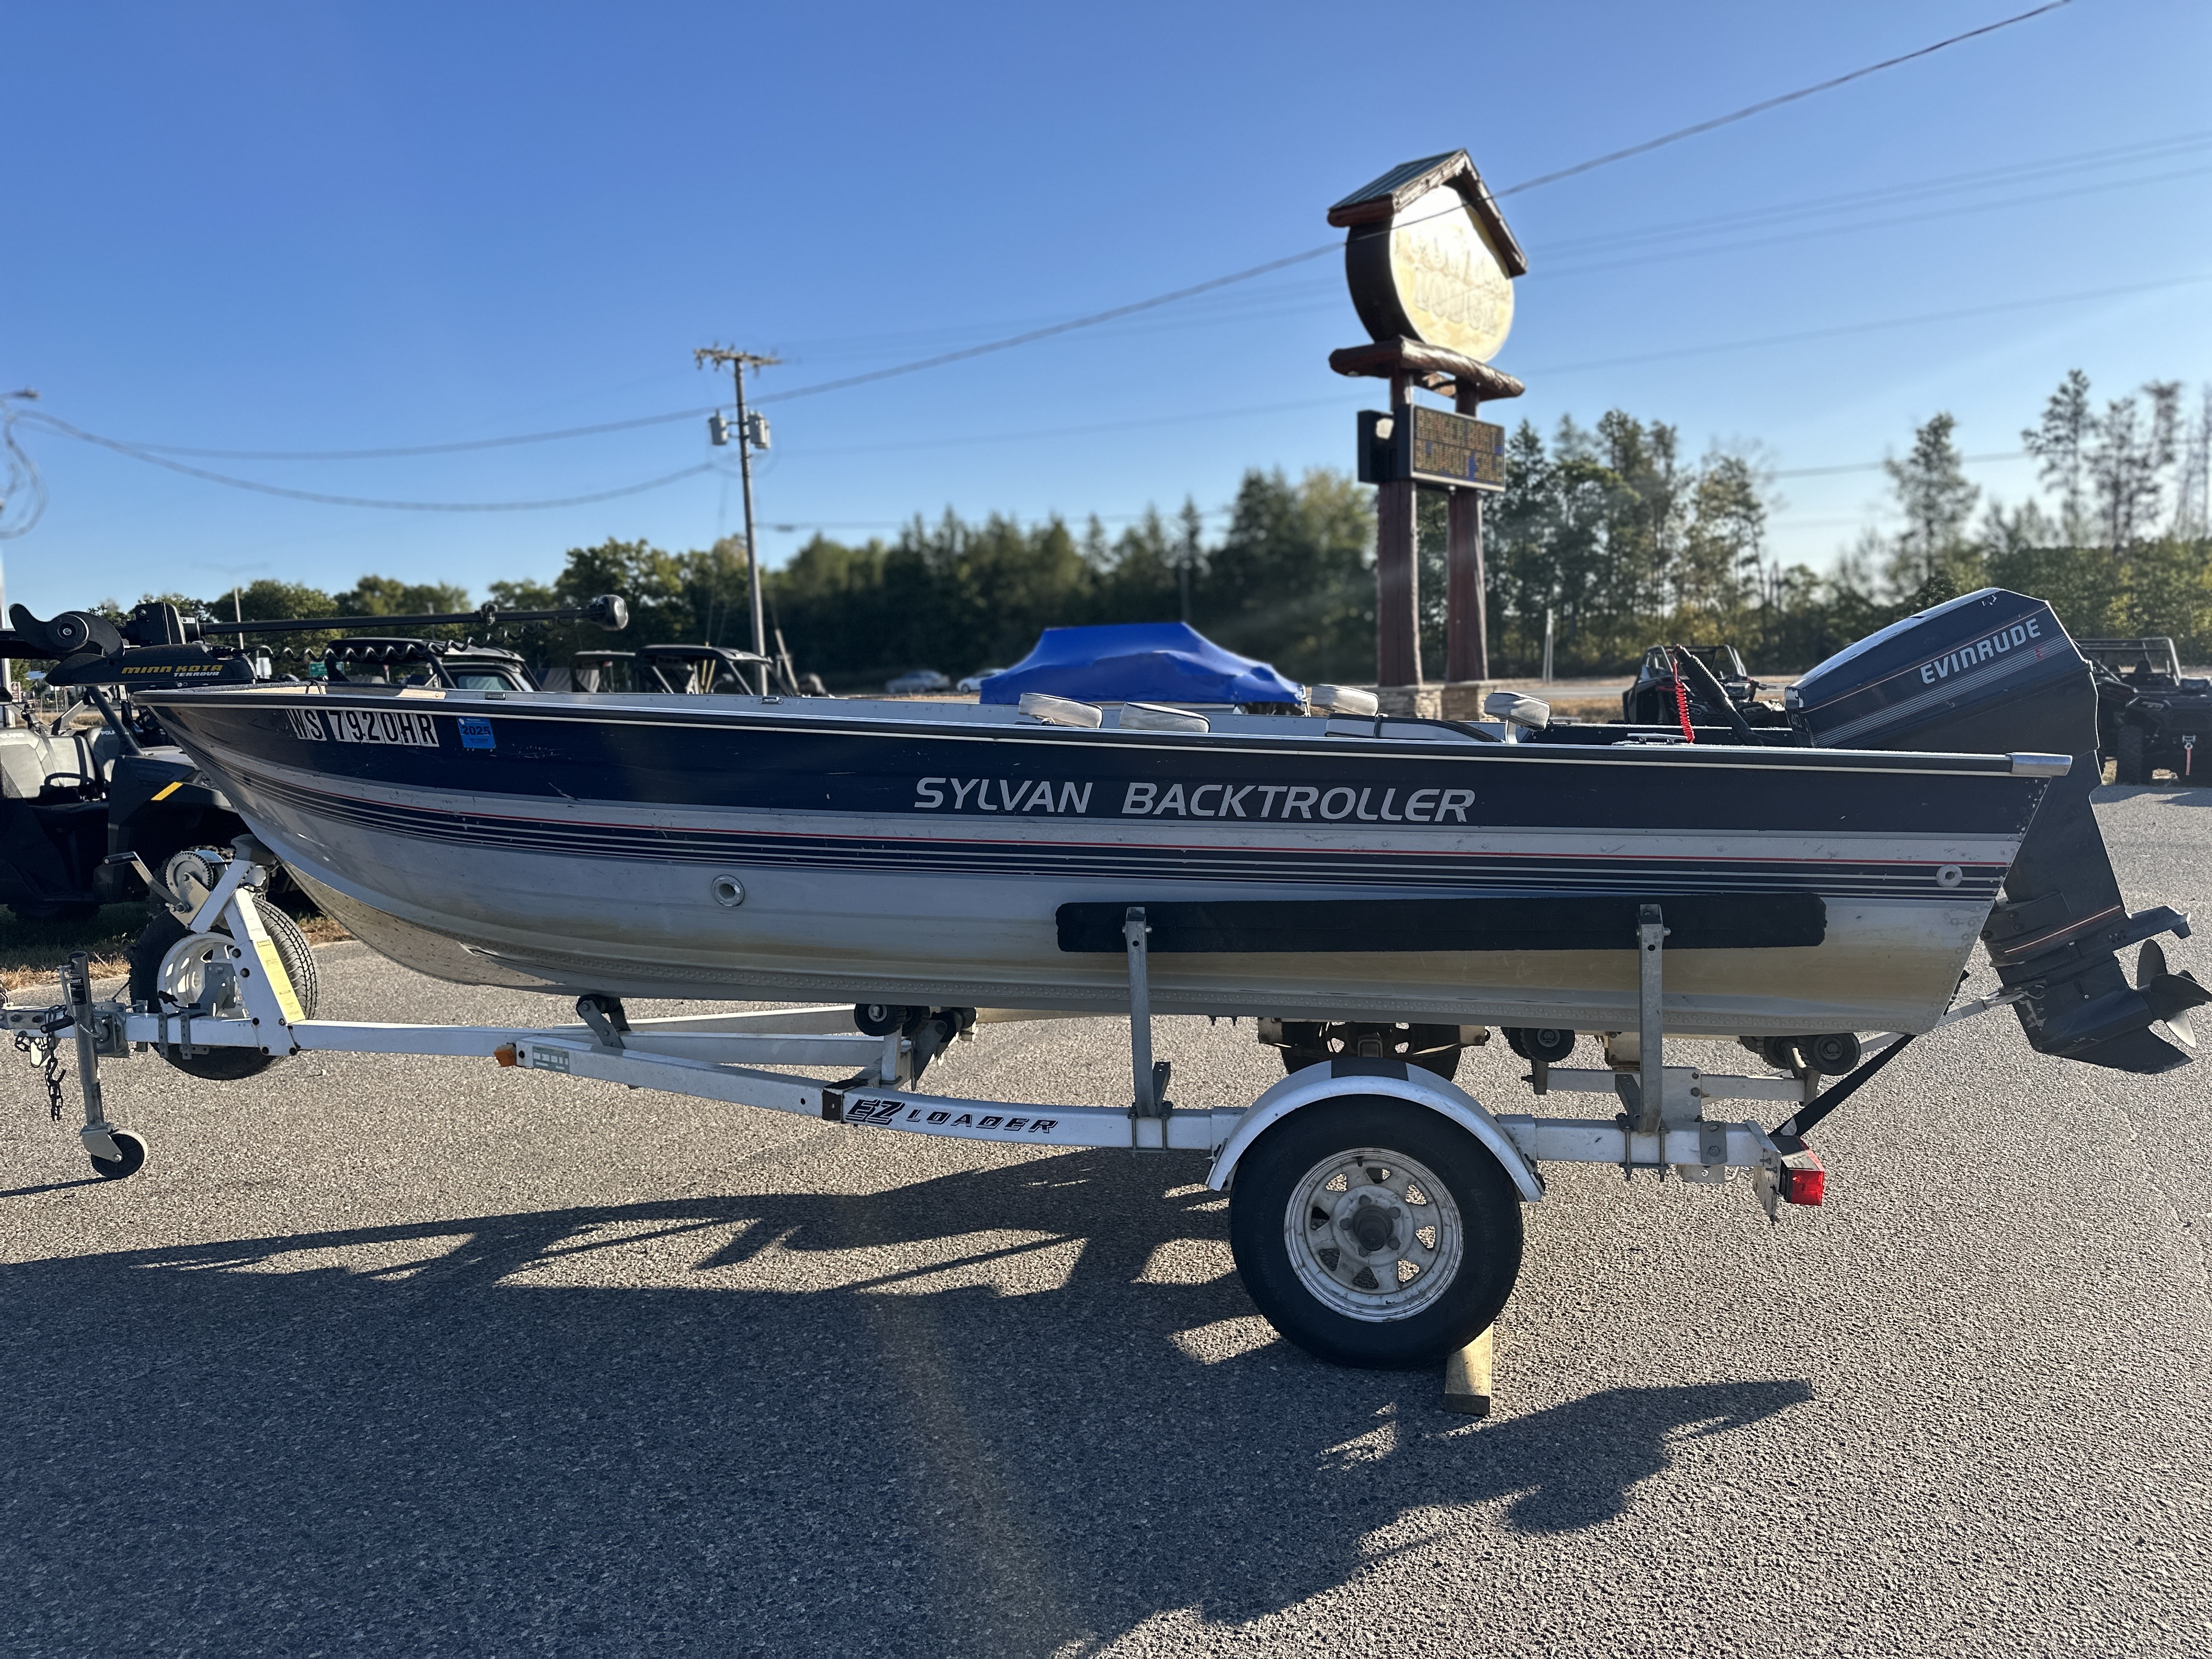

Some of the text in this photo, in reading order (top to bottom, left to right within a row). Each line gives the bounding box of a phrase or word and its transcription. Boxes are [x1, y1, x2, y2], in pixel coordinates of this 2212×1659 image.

[1921, 618, 2041, 684] EVINRUDE
[286, 709, 323, 740] WS
[461, 726, 490, 735] 2025
[1791, 714, 1802, 728] 40
[915, 778, 1475, 822] SYLVAN BACKTROLLER
[845, 1099, 1058, 1133] EZ LOADER
